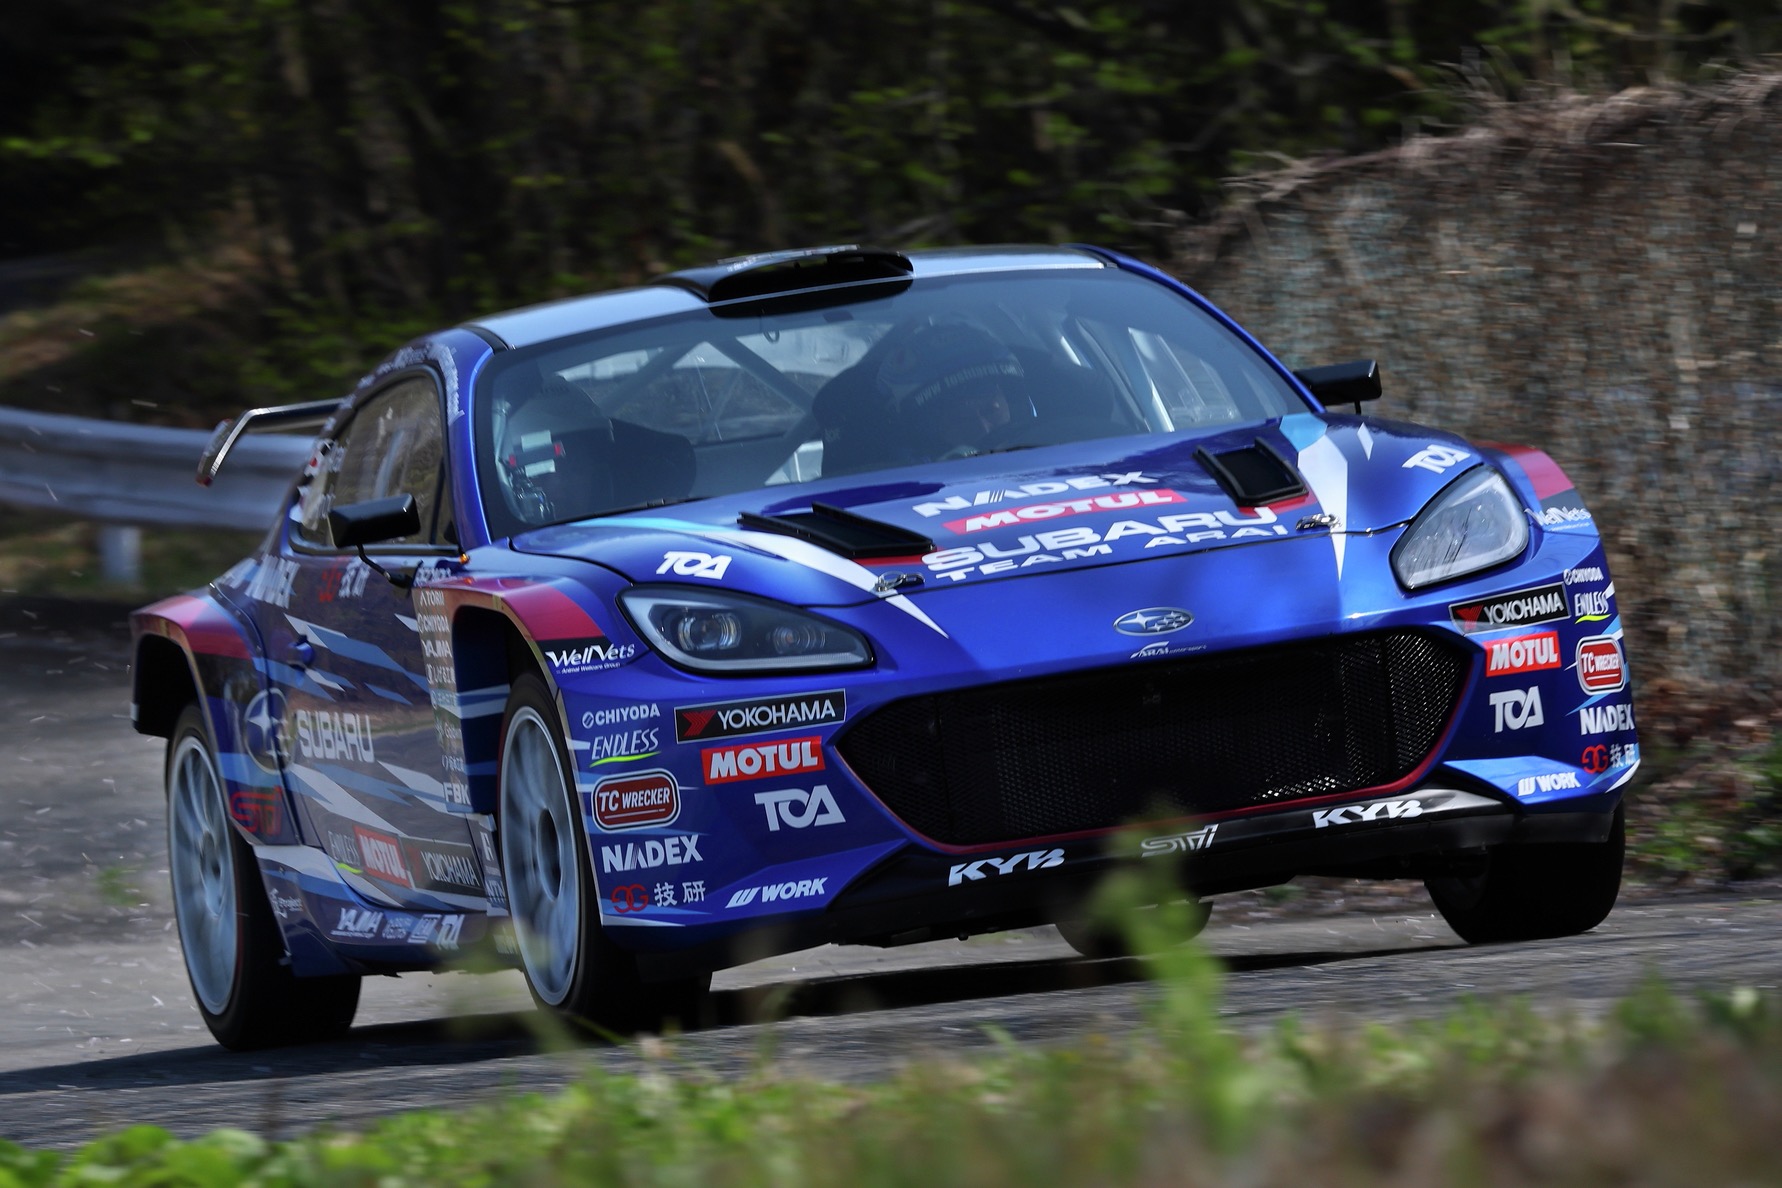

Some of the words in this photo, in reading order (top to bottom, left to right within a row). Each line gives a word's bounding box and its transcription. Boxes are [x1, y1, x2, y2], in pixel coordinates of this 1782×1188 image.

[1402, 445, 1470, 474] TOA
[912, 471, 1159, 518] NADEX
[966, 491, 1172, 532] MOTUL
[921, 507, 1277, 572] SUBARU
[935, 543, 1112, 582] TEAM
[1144, 524, 1288, 549] ARAI
[656, 551, 732, 580] TOA
[1483, 593, 1564, 625] YOKOHAMA
[1574, 591, 1609, 617] ENDLESS
[545, 643, 635, 668] WellVets
[1490, 637, 1557, 671] MOTUL
[1581, 652, 1595, 674] TC
[595, 703, 660, 725] CHIYODA
[718, 699, 836, 730] YOKOHAMA
[1490, 686, 1544, 733] TOA
[1580, 703, 1635, 735] NADEX
[297, 709, 375, 763] SUBARU
[591, 727, 659, 761] ENDLESS
[709, 741, 818, 779] MOTUL
[443, 782, 471, 805] FBK
[1536, 771, 1581, 793] WORK
[599, 790, 619, 812] TC
[622, 787, 670, 809] WRECKER
[754, 784, 846, 831] TOA
[1312, 800, 1423, 828] KYB
[359, 834, 406, 880] MOTUL
[421, 851, 480, 886] YOKOHAMA
[601, 834, 704, 873] NADEX
[948, 848, 1065, 887] KYB
[654, 880, 706, 907] 技研
[761, 876, 828, 903] WORK
